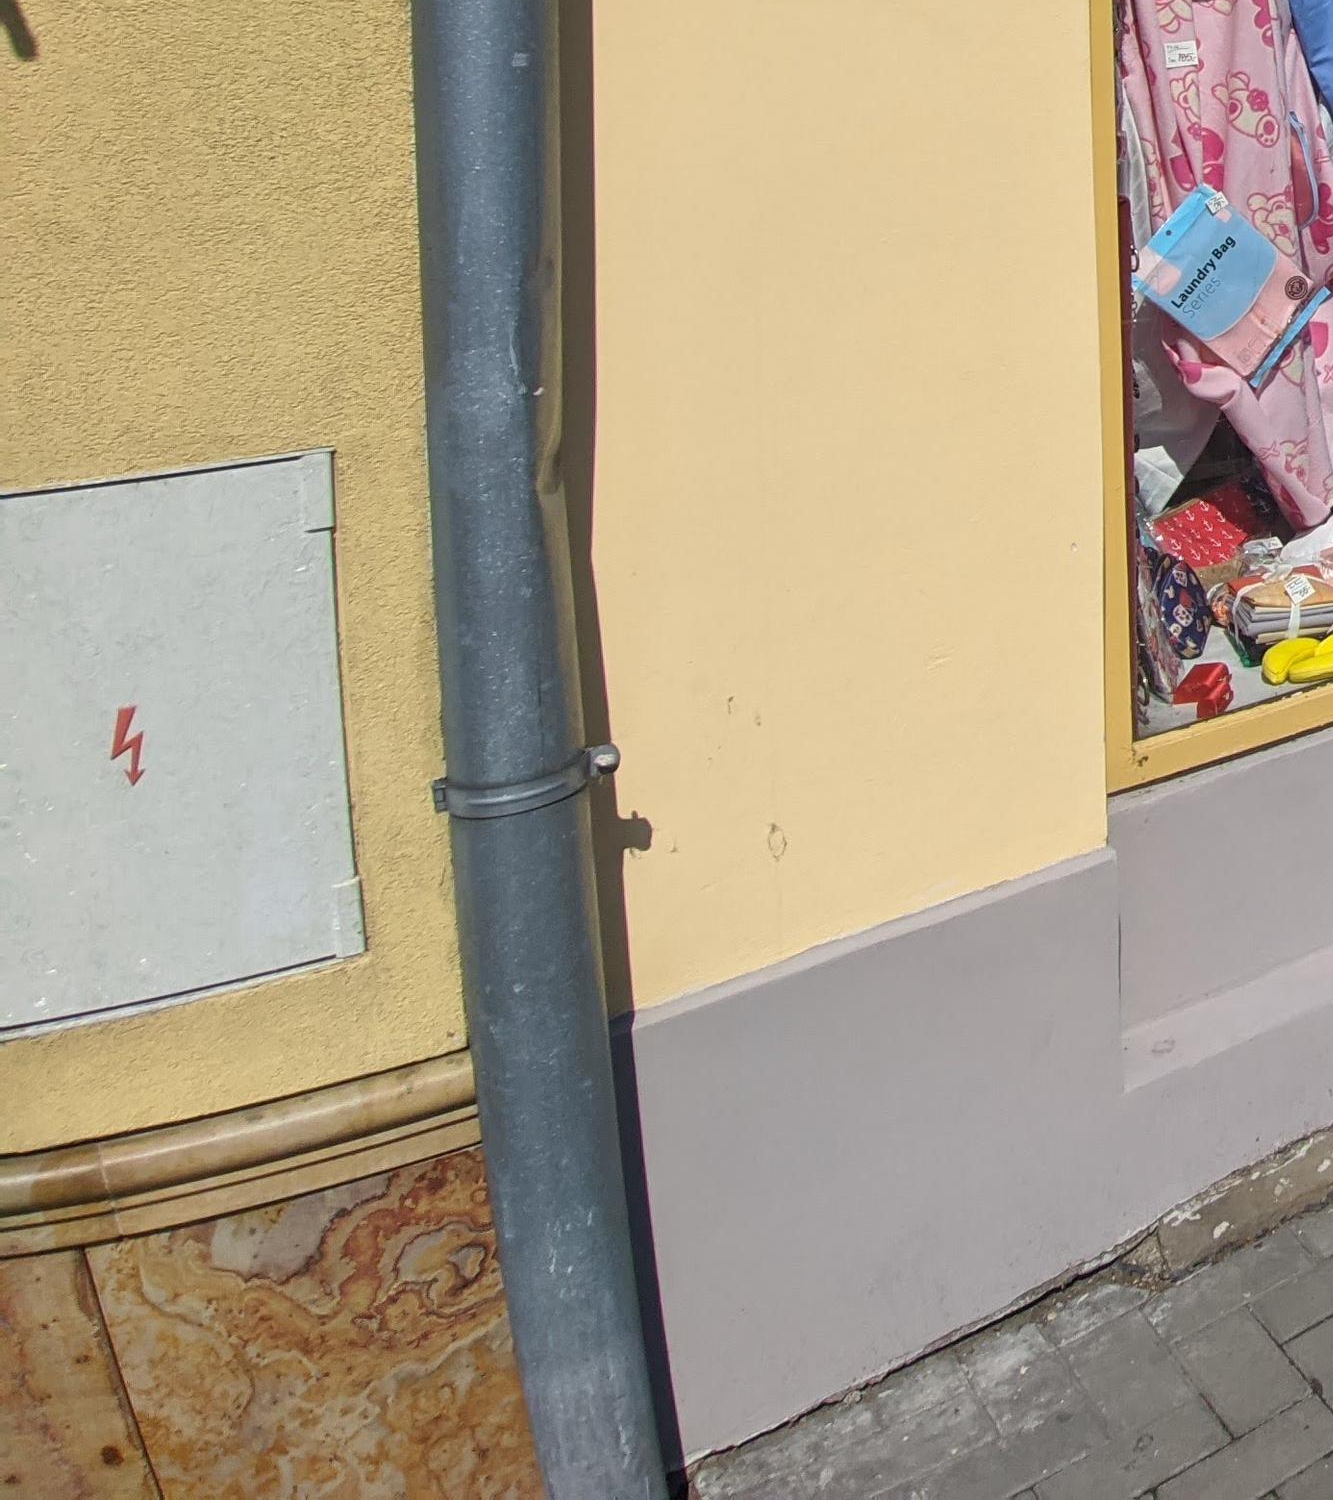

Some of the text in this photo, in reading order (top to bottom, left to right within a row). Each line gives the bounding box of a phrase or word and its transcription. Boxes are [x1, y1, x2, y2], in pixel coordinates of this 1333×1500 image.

[1171, 256, 1217, 308] Laundry
[1213, 234, 1236, 260] Bag
[1182, 276, 1221, 318] Series
